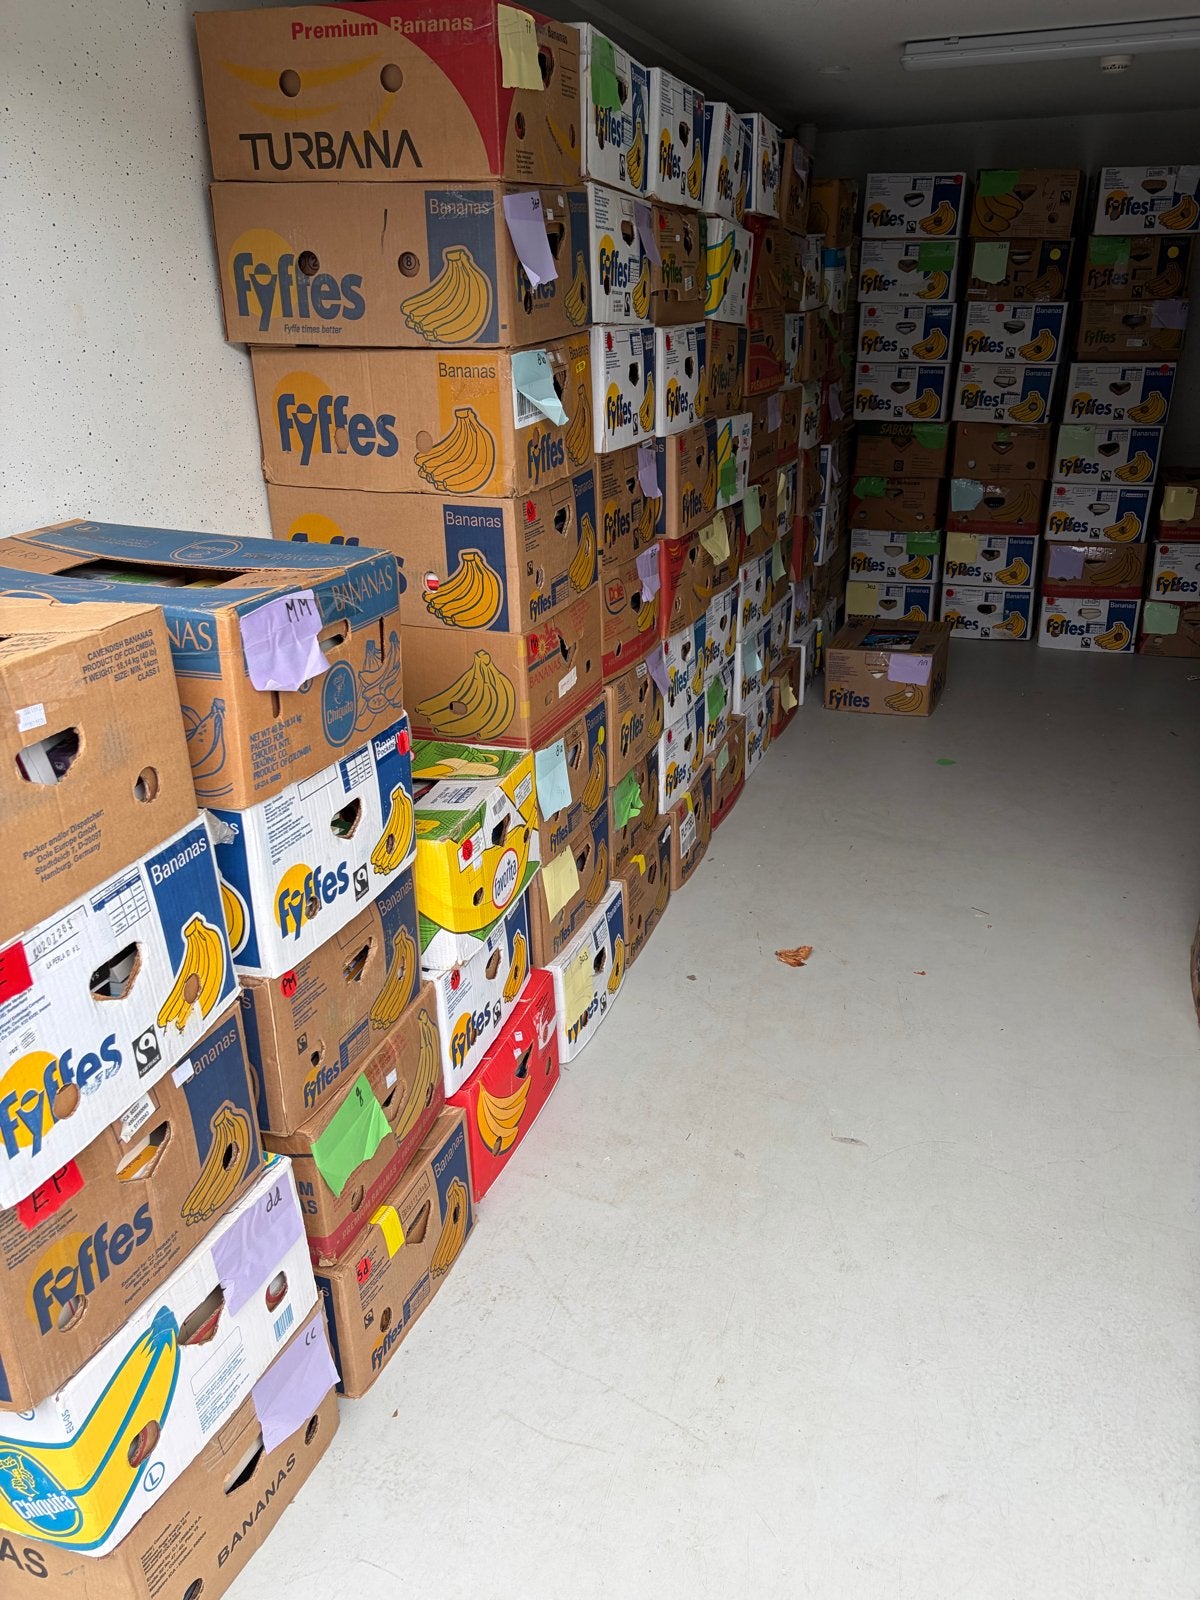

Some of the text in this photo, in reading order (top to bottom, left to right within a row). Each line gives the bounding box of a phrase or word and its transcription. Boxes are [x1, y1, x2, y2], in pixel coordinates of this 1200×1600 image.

[292, 15, 473, 40] Premium Bananas
[239, 130, 423, 170] TURBANA
[429, 198, 490, 216] Bananas
[232, 251, 366, 332] fyffes
[284, 324, 343, 335] Fyffe times better
[438, 362, 496, 379] Bananas
[276, 393, 399, 466] fyffes
[446, 511, 502, 528] Bananas
[331, 565, 393, 612] BANANAS
[285, 599, 312, 622] MM
[82, 639, 155, 674] PRODUCT OF COLOMBIA
[88, 628, 154, 661] CAVENDISH BANANAS
[89, 666, 116, 684] WEIGHT:
[114, 670, 130, 682] SIZE:
[137, 668, 157, 682] CLASS
[528, 659, 562, 688] BANANAS
[326, 702, 354, 724] Chiquita
[829, 688, 870, 710] fyffes
[22, 842, 48, 860] Packer
[70, 810, 105, 834] Dispatcher:
[37, 823, 98, 864] Dole Europe GmbH
[41, 842, 101, 882] Hamburg, Germany
[150, 836, 208, 886] Bananas
[495, 860, 516, 899] favorita
[279, 860, 350, 941] fyffes
[378, 878, 414, 918] Bananas
[452, 1000, 491, 1070] fyffes
[186, 1028, 237, 1084] ananas
[0, 1033, 123, 1161] fyffes
[304, 1060, 340, 1108] fyffes
[434, 1130, 464, 1178] Bananas
[371, 1165, 398, 1203] BANANAS
[32, 1202, 154, 1336] fyffes
[372, 1318, 403, 1372] fyffes
[12, 1490, 77, 1522] Chiquita
[217, 1452, 297, 1569] BANANAS
